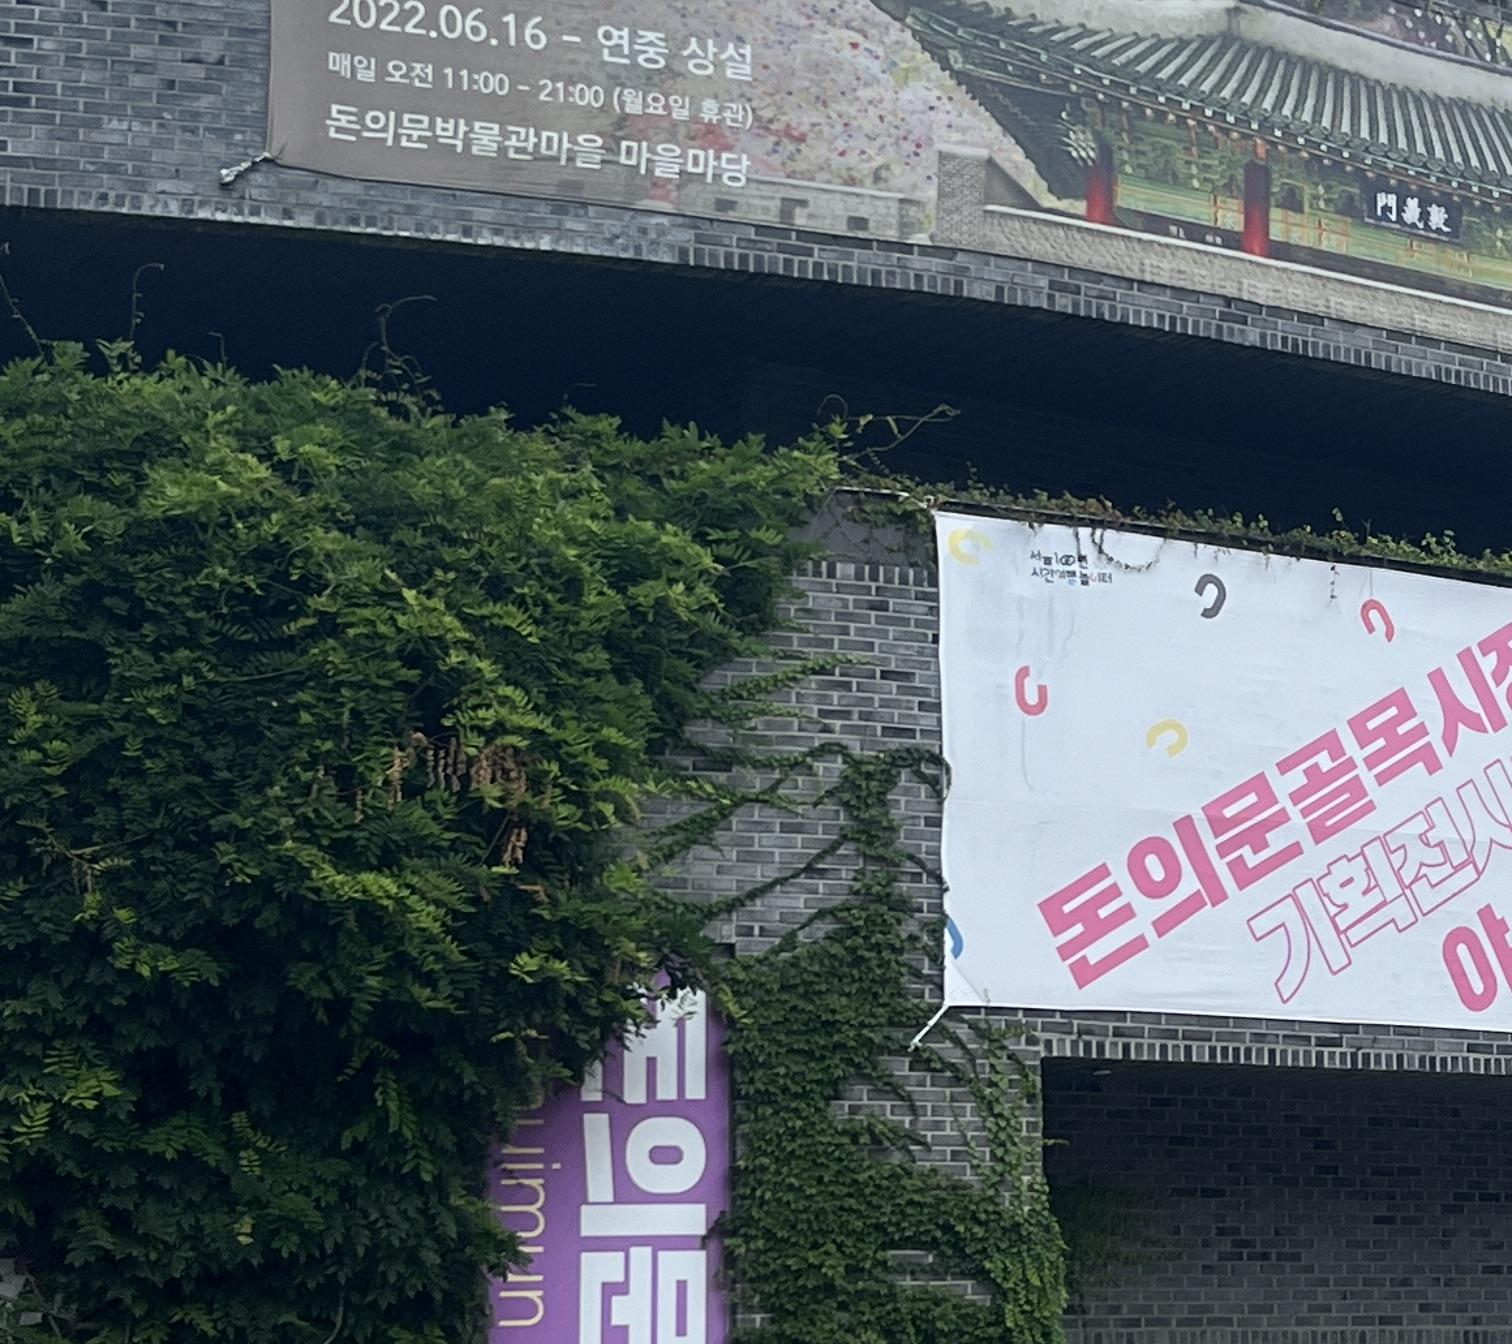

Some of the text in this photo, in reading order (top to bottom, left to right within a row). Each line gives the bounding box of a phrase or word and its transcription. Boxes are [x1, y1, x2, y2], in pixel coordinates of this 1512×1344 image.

[327, 51, 377, 84] 매일
[384, 59, 434, 89] 오전
[442, 67, 510, 96] 11:00
[538, 78, 605, 109] 21:00
[612, 86, 691, 121] (월요일
[699, 98, 754, 131] 휴관)
[596, 24, 670, 70] 연중
[681, 36, 753, 82] 상설
[325, 103, 752, 188] 돈의문박물관마을 마을마당
